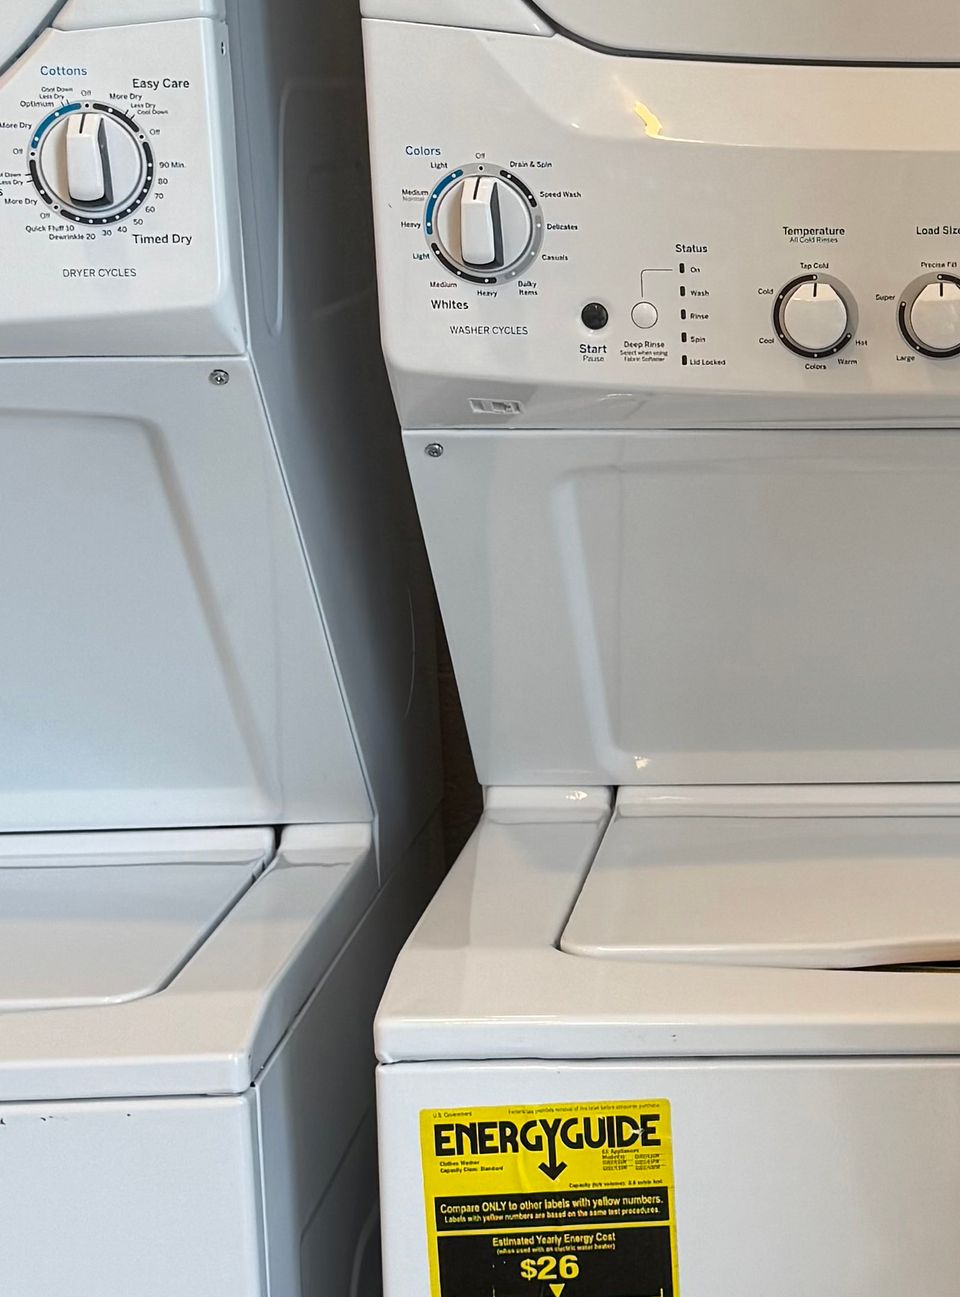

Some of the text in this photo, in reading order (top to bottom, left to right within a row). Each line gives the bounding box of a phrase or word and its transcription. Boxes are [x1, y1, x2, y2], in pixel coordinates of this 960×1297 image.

[40, 66, 88, 76] Cottons
[132, 78, 190, 90] Easy Care
[129, 93, 143, 101] Dry
[19, 122, 32, 130] Dry
[405, 145, 441, 156] Colors
[24, 198, 38, 206] Dry
[133, 218, 144, 226] 50
[783, 226, 845, 238] Temperature
[916, 226, 940, 235] Load
[86, 233, 96, 241] 20
[132, 234, 192, 246] Timed Dry
[675, 243, 708, 254] Status
[63, 268, 137, 278] DRYER CYCLES
[477, 289, 498, 298] Heavy
[690, 289, 710, 297] Wash
[431, 299, 469, 311] Whites
[449, 326, 529, 336] WASHER CYCLES
[623, 340, 665, 349] Deep Rinse
[759, 337, 775, 345] Cool
[579, 343, 608, 355] Start
[896, 355, 916, 363] Large
[804, 363, 827, 371] Colors
[433, 1114, 661, 1157] ENERGYGUIDE
[440, 1204, 480, 1215] Compare
[482, 1202, 506, 1212] ONLY
[508, 1203, 518, 1211] to
[520, 1201, 543, 1211] other
[544, 1199, 571, 1210] labels
[572, 1198, 591, 1208] with
[622, 1195, 664, 1205] numbers.
[492, 1232, 616, 1247] Estimated Yearly Energy Cost
[520, 1255, 580, 1280] $26
